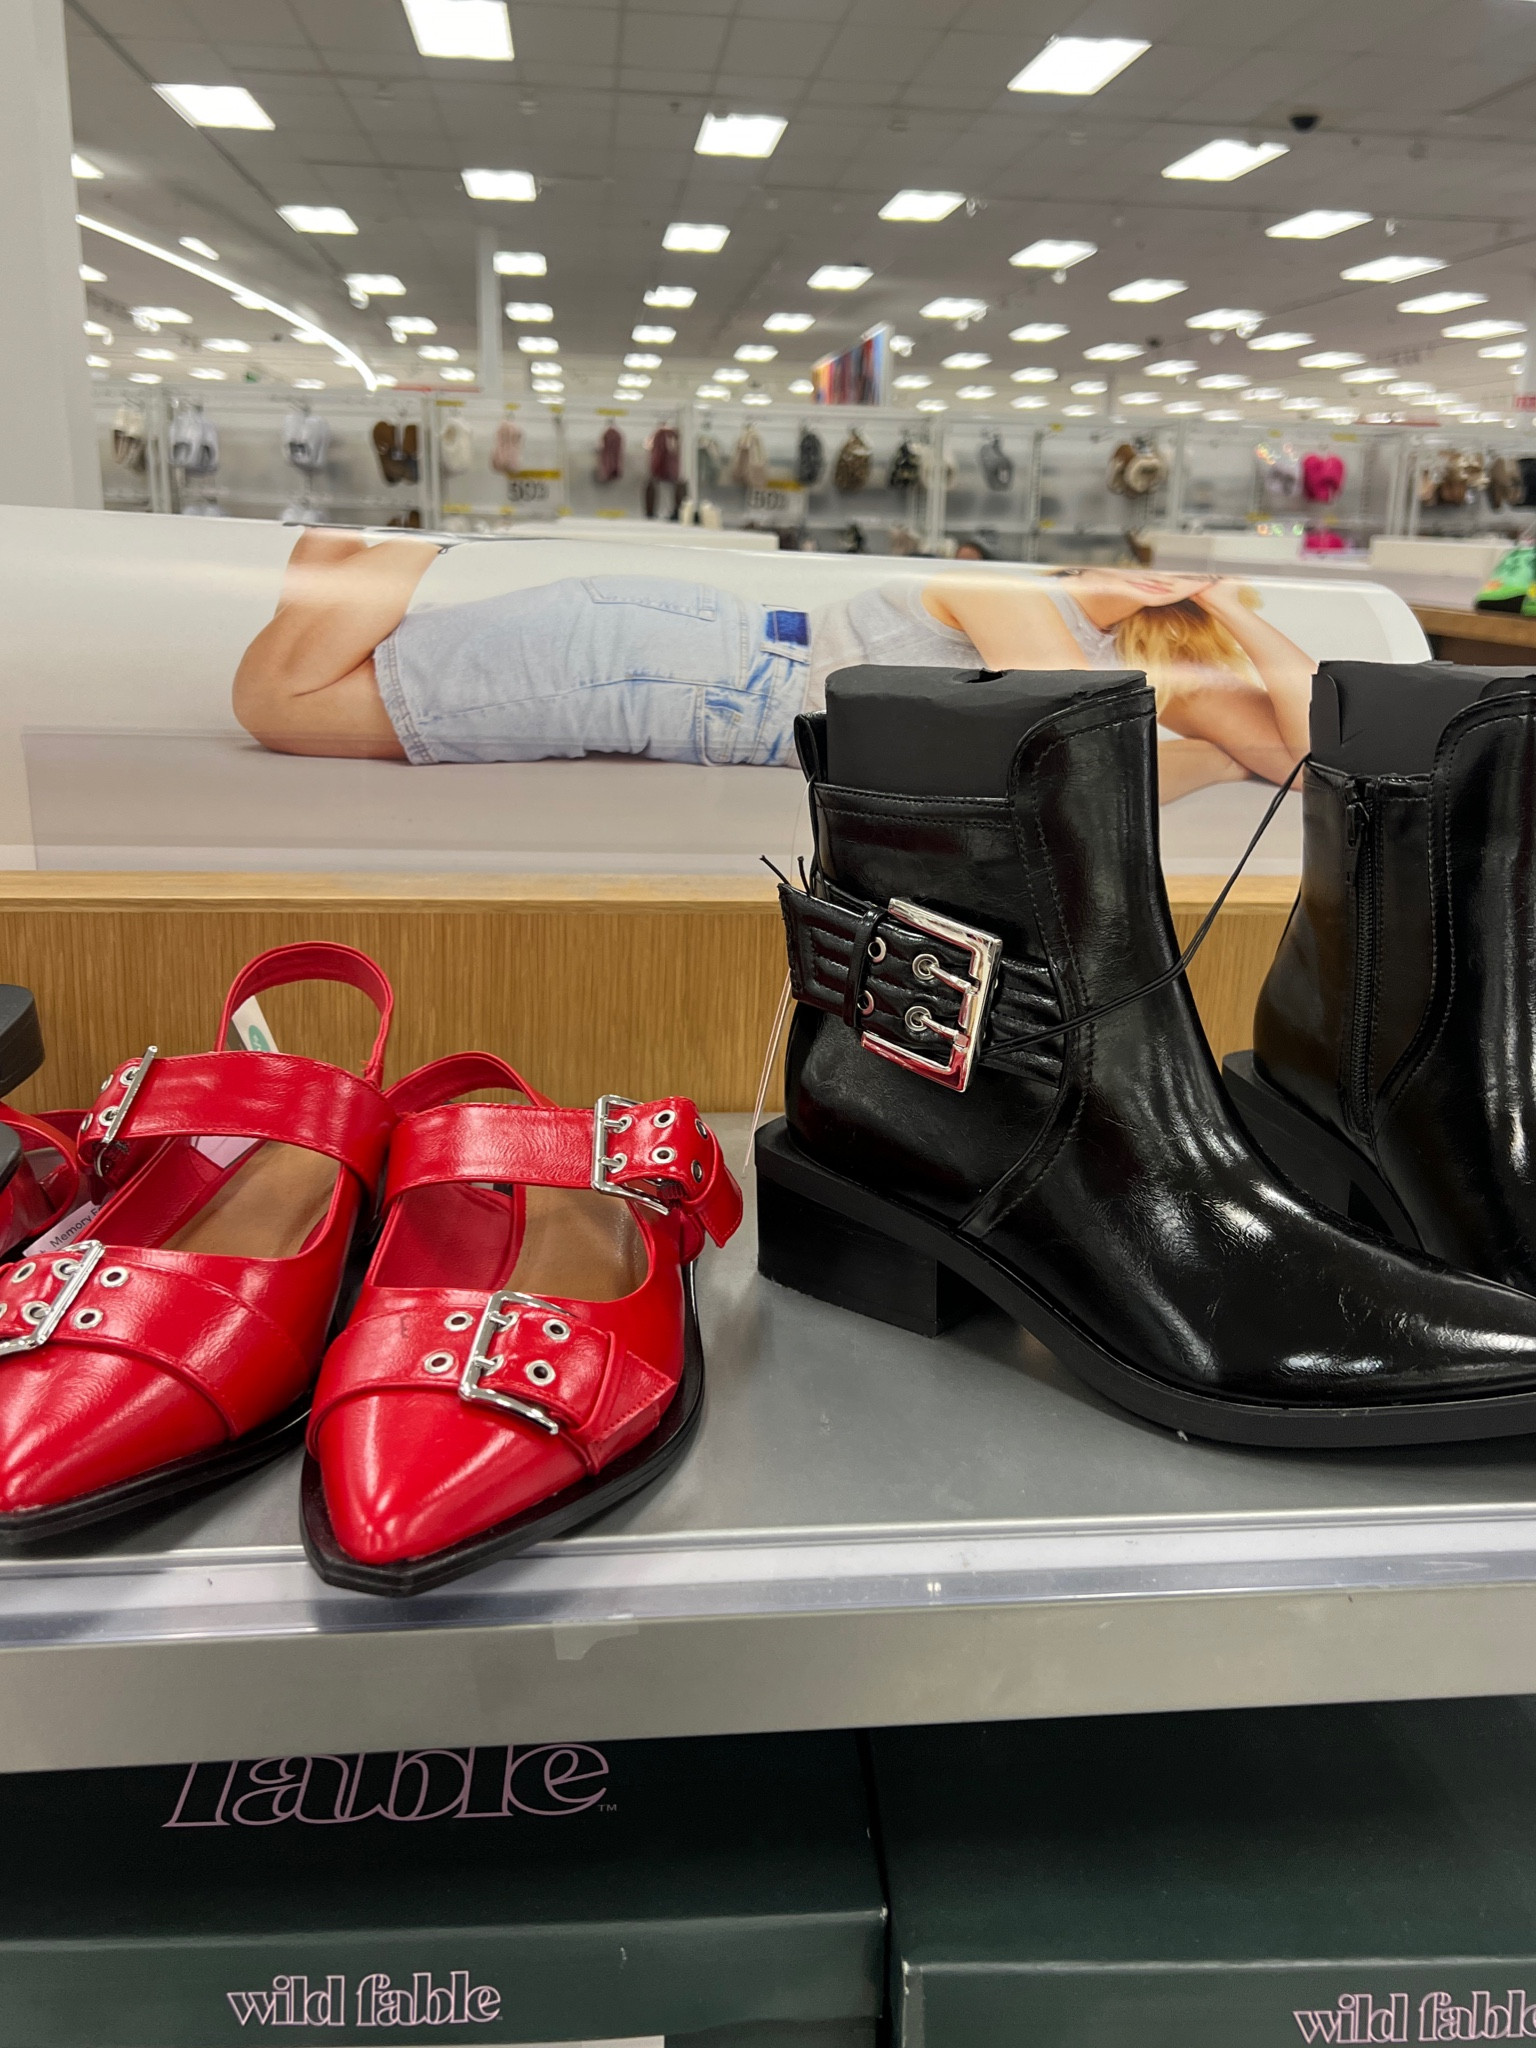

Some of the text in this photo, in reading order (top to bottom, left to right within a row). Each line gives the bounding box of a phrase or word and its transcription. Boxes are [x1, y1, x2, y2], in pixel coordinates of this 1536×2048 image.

[226, 1970, 501, 2026] wild fable
[1292, 1993, 1409, 2044] wild
